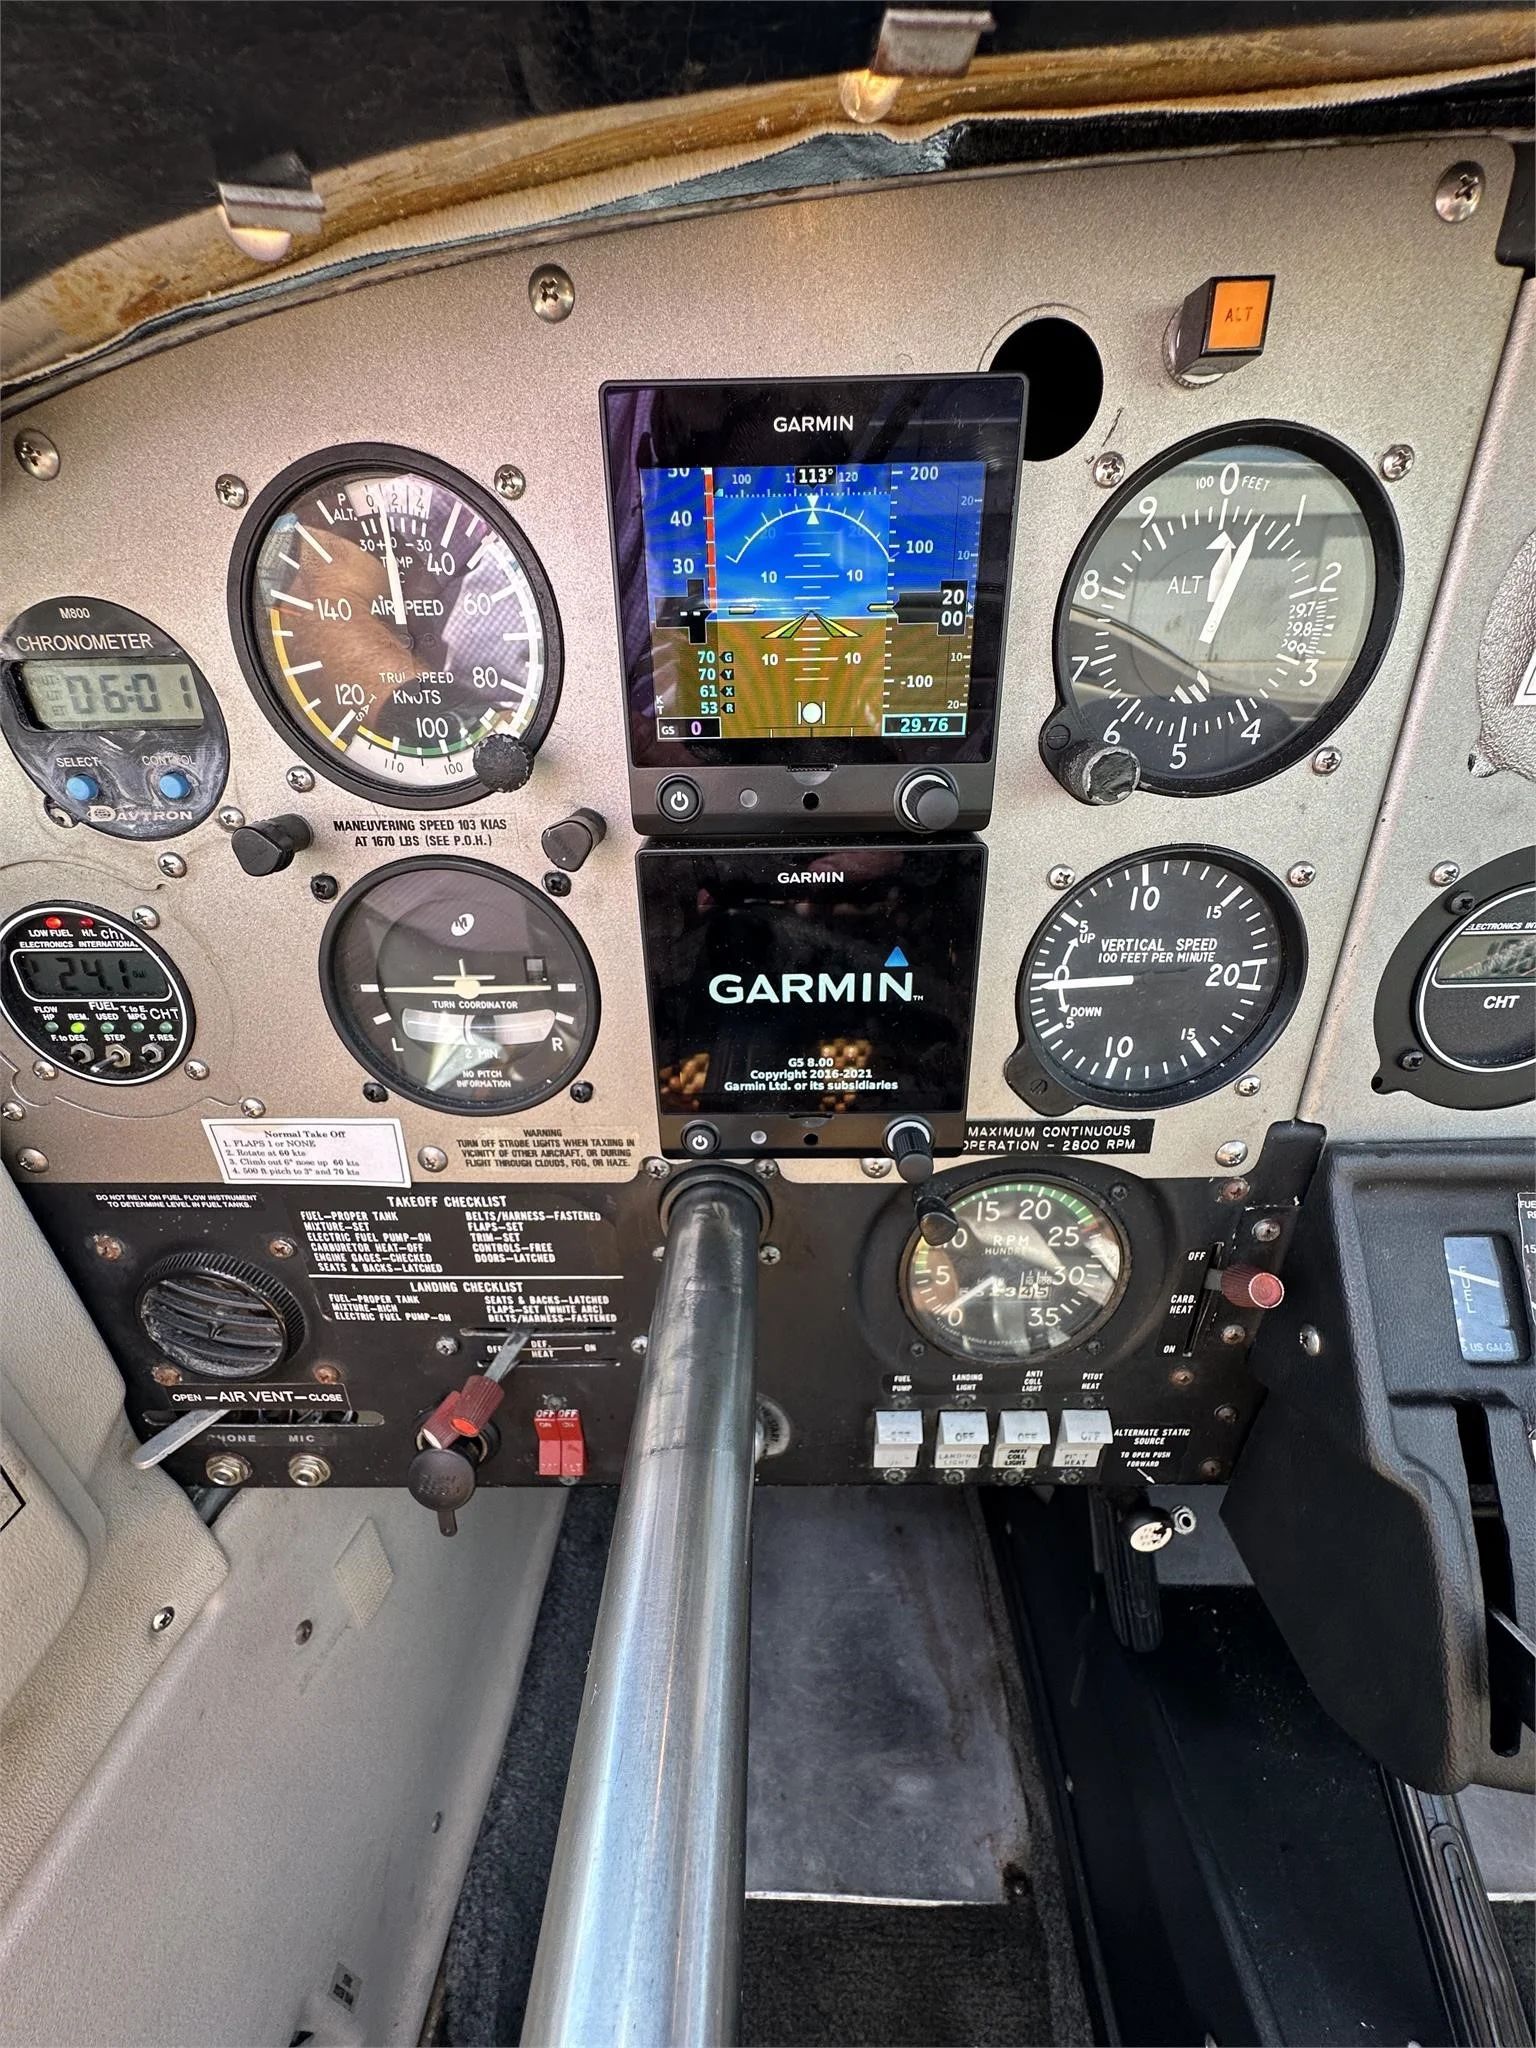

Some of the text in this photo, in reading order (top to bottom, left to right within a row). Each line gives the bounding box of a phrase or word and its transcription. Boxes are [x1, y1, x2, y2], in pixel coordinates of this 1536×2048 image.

[773, 416, 854, 432] GARMIN
[839, 472, 858, 482] 120
[910, 466, 938, 480] 200
[1220, 463, 1239, 494] 0
[1196, 477, 1213, 489] 100
[1242, 475, 1270, 491] FEET
[670, 511, 692, 526] 40
[1139, 496, 1157, 528] 9
[906, 540, 933, 553] 100
[427, 552, 455, 576] 40
[672, 559, 694, 574] 30
[1319, 562, 1341, 592] 2
[1081, 570, 1100, 599] 8
[1167, 576, 1203, 594] ALT
[942, 589, 964, 604] 20
[317, 598, 352, 620] 140
[464, 593, 491, 615] 60
[60, 608, 90, 618] M800
[941, 611, 963, 626] 00
[16, 634, 153, 651] CHRONOMETER
[698, 651, 715, 663] 70
[1071, 657, 1090, 682] 7
[1299, 660, 1317, 686] 3
[473, 667, 498, 688] 80
[901, 675, 933, 688] -100
[335, 684, 364, 705] 120
[393, 691, 441, 704] KNOTS
[416, 718, 448, 738] 100
[661, 726, 675, 735] GS
[900, 718, 949, 732] 29.76
[1103, 720, 1120, 743] 6
[1241, 720, 1261, 744] 4
[57, 757, 99, 767] SELECT
[1169, 744, 1187, 769] 5
[334, 819, 507, 830] MANEUVERING SPEED 103 KIAS
[355, 836, 492, 847] AT 1670 LBS (SEE P.O.H.)
[777, 872, 844, 883] GARMIN
[1130, 886, 1160, 911] 10
[1206, 906, 1222, 919] 15
[1080, 933, 1095, 943] UP
[1101, 938, 1217, 951] VERTICAL SPEED
[1098, 952, 1215, 963] 100 FEET PER MINUTE
[1205, 964, 1240, 986] 20
[709, 972, 913, 1004] GARMIN
[89, 1003, 119, 1011] FUEL
[432, 1001, 518, 1009] TURN COORDINATOR
[1483, 995, 1520, 1009] CHT
[150, 1008, 178, 1020] CHT
[1070, 1007, 1102, 1016] DOWN
[392, 1038, 404, 1051] L
[552, 1038, 563, 1051] R
[1106, 1037, 1133, 1057] 10
[788, 1058, 834, 1067] G5 8.00
[463, 1070, 502, 1078] NO PITCH
[751, 1069, 872, 1080] Copyright 2016-2021
[457, 1080, 511, 1088] INFORMATION
[725, 1080, 898, 1091] Garmin Ltd. or its subsidiaries
[523, 1129, 562, 1137] WARNING
[968, 1125, 1131, 1138] MAXIMUM CONTINUOUS
[533, 1139, 560, 1147] LIGHTS
[564, 1139, 587, 1147] WHEN
[590, 1139, 623, 1147] TAXIING
[1062, 1140, 1099, 1151] 2800
[1106, 1139, 1136, 1150] RPM
[387, 1196, 506, 1207] TAKEOFF CHECKLIST
[977, 1201, 999, 1221] 15
[1019, 1199, 1051, 1220] 20
[372, 1212, 398, 1221] TANK
[307, 1233, 350, 1242] ELECTRIC
[355, 1233, 378, 1242] FUEL
[1049, 1226, 1080, 1246] 25
[311, 1243, 372, 1252] CARBURETOR
[314, 1253, 347, 1262] ENGINE
[1188, 1252, 1206, 1260] OFF
[1052, 1266, 1085, 1285] 30
[410, 1282, 523, 1292] LANDING CHECKLIST
[1171, 1295, 1196, 1303] CARB.
[1170, 1306, 1193, 1314] HEAT
[1029, 1308, 1059, 1326] 35
[1163, 1345, 1175, 1353] ON
[1470, 1343, 1512, 1352] US GALS
[173, 1391, 343, 1402] OPEN AIR VENT CLOSE
